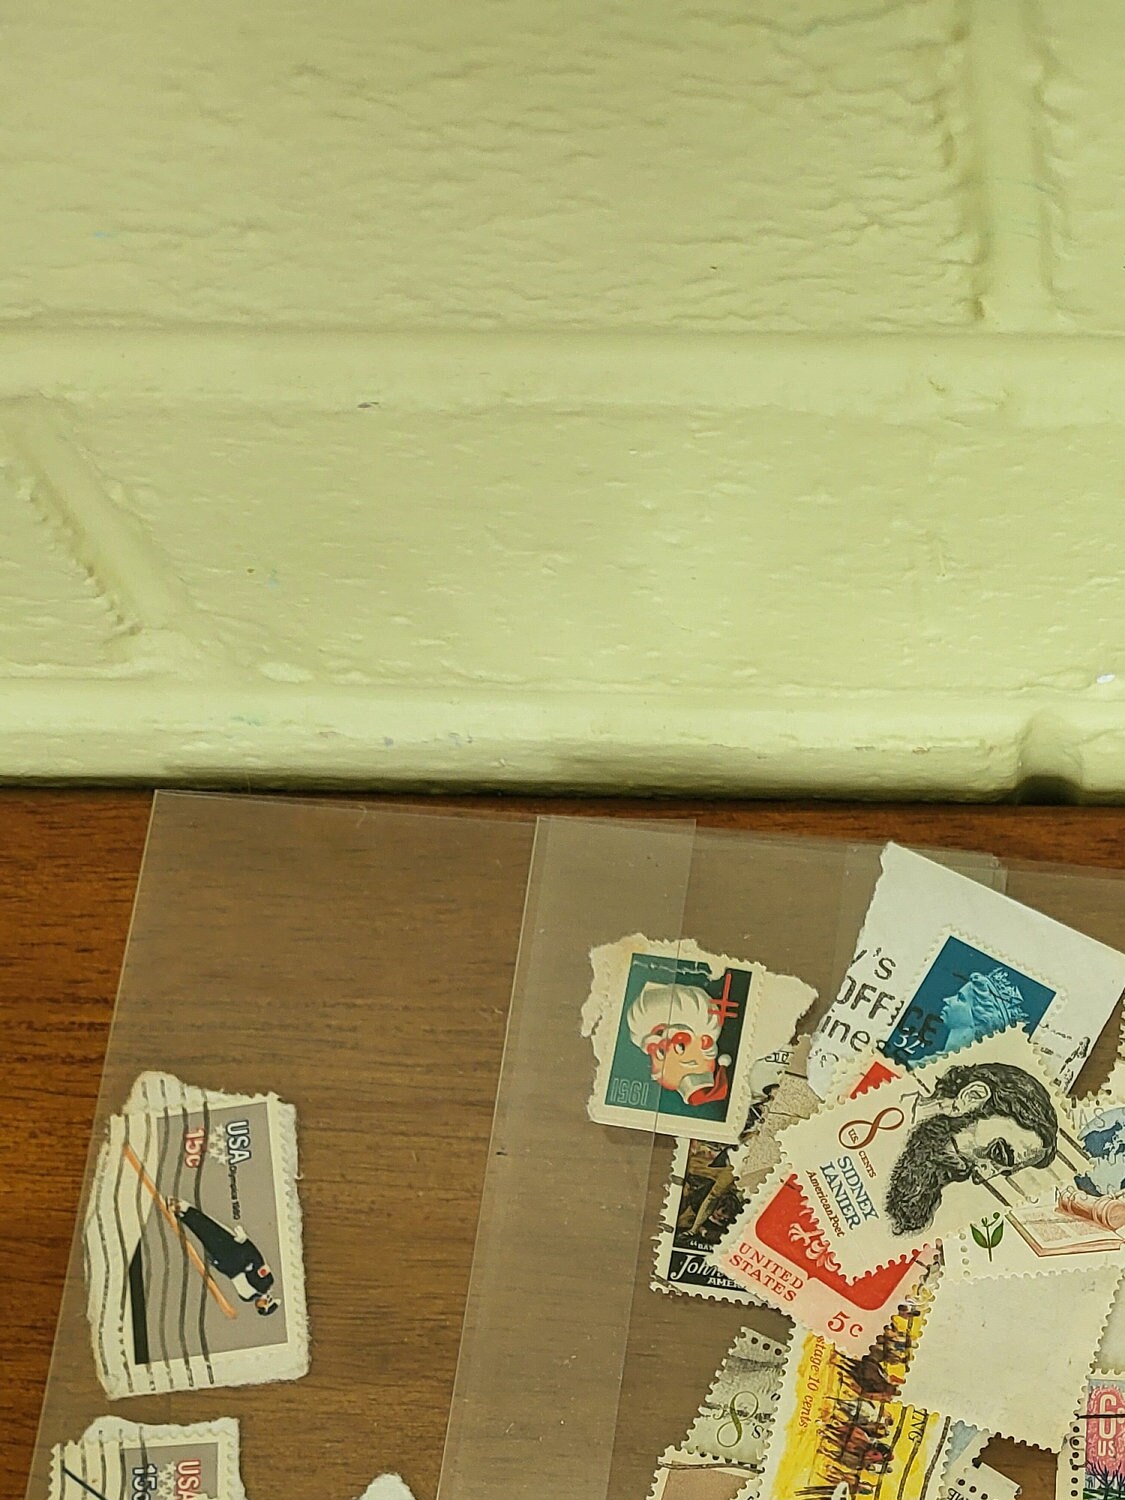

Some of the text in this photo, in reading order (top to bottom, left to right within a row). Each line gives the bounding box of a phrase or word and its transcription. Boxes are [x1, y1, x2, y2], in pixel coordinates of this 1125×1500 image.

[226, 1119, 251, 1164] USA
[858, 1150, 877, 1179] CENTS
[805, 1169, 846, 1238] American Poet
[819, 1160, 862, 1231] LANIER
[836, 1155, 880, 1221] SIDNEY
[728, 1254, 797, 1302] STATES
[738, 1242, 805, 1290] UNITED
[808, 1334, 826, 1375] stage
[798, 1391, 815, 1430] cents
[1097, 1440, 1116, 1457] US
